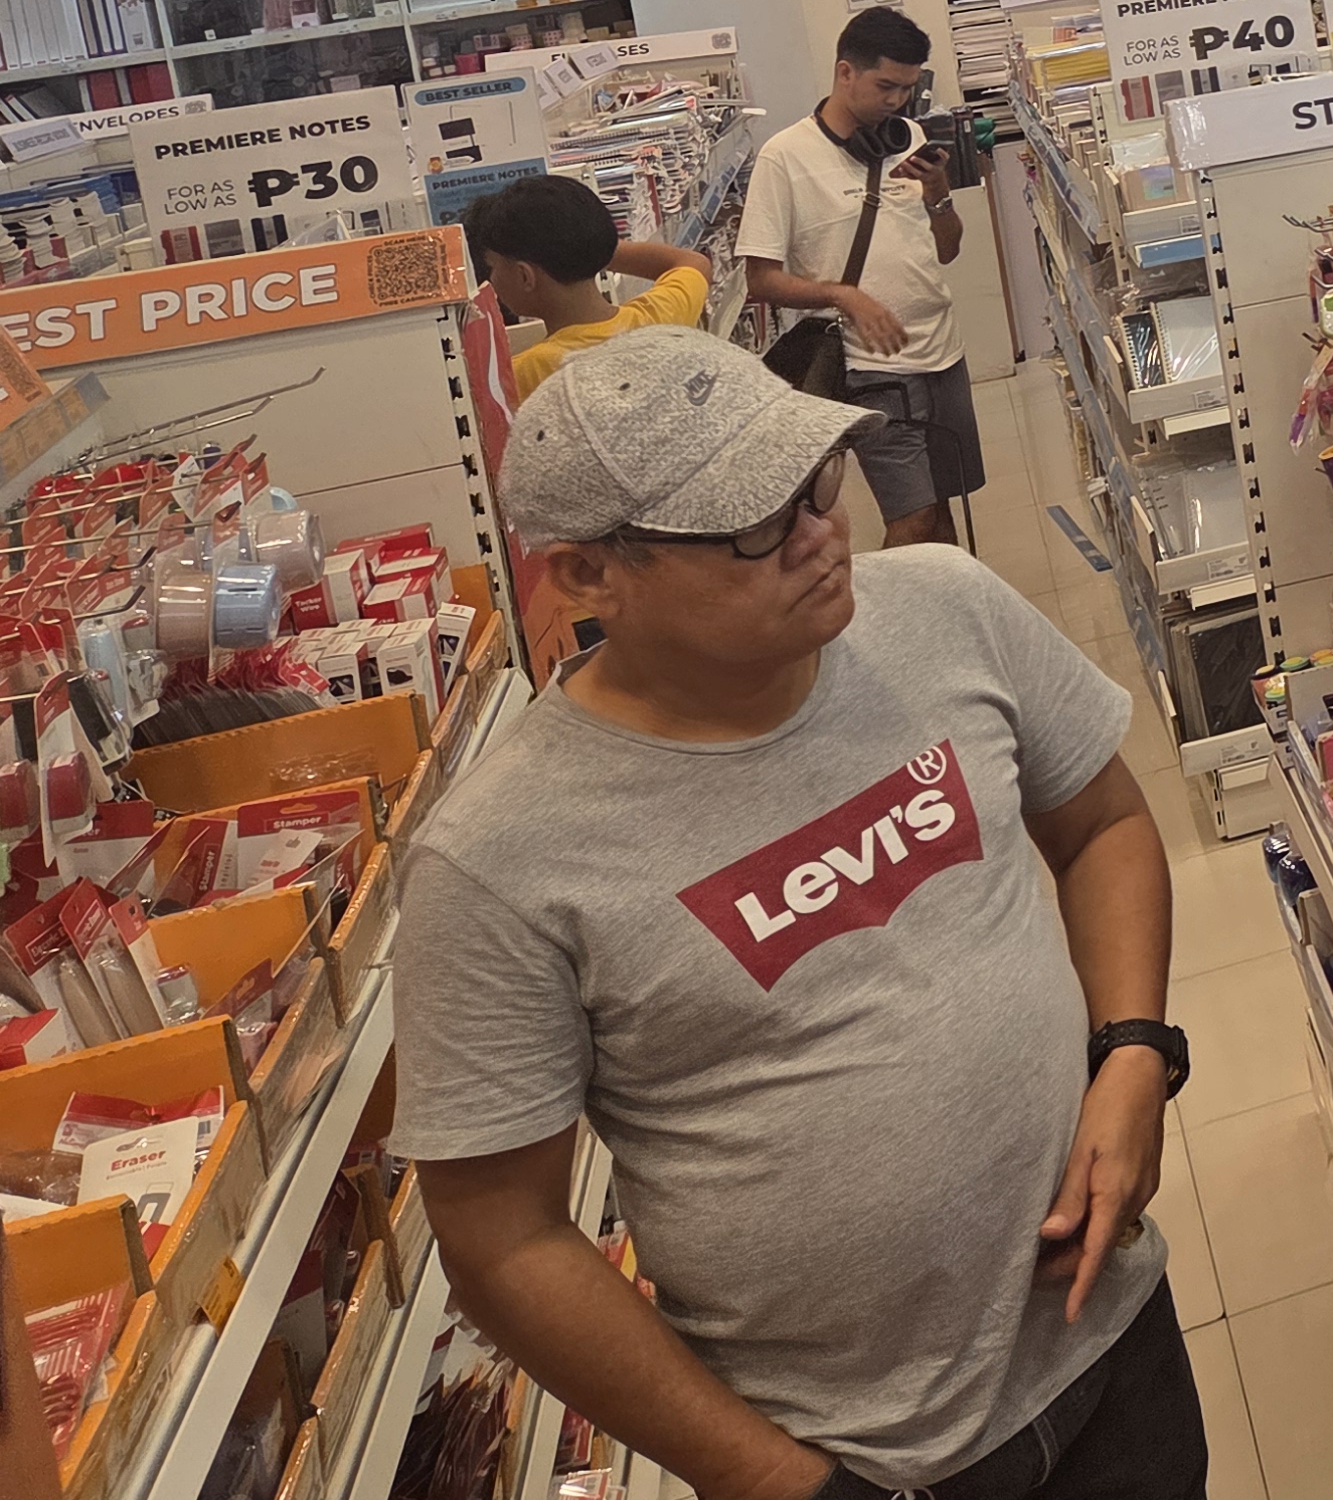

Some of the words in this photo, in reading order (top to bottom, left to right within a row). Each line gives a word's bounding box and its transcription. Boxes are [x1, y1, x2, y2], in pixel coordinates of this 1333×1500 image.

[1126, 38, 1157, 52] FOR
[1160, 35, 1179, 48] AS
[1124, 51, 1159, 66] LOW
[1162, 47, 1181, 60] AS
[425, 84, 463, 101] BEST
[466, 79, 513, 97] SELLER
[71, 106, 180, 133] NVELOPES
[155, 123, 282, 160] PREMIERE
[289, 114, 371, 142] NOTES
[167, 183, 203, 200] FOR
[208, 180, 234, 195] AS
[432, 174, 494, 191] PREMIERE
[499, 165, 539, 182] NOTES
[164, 198, 206, 216] LOW
[210, 192, 237, 208] AS
[141, 264, 338, 331] PRICE
[273, 814, 322, 831] Stamper
[198, 850, 215, 892] Stamper
[110, 1148, 167, 1172] Eraser
